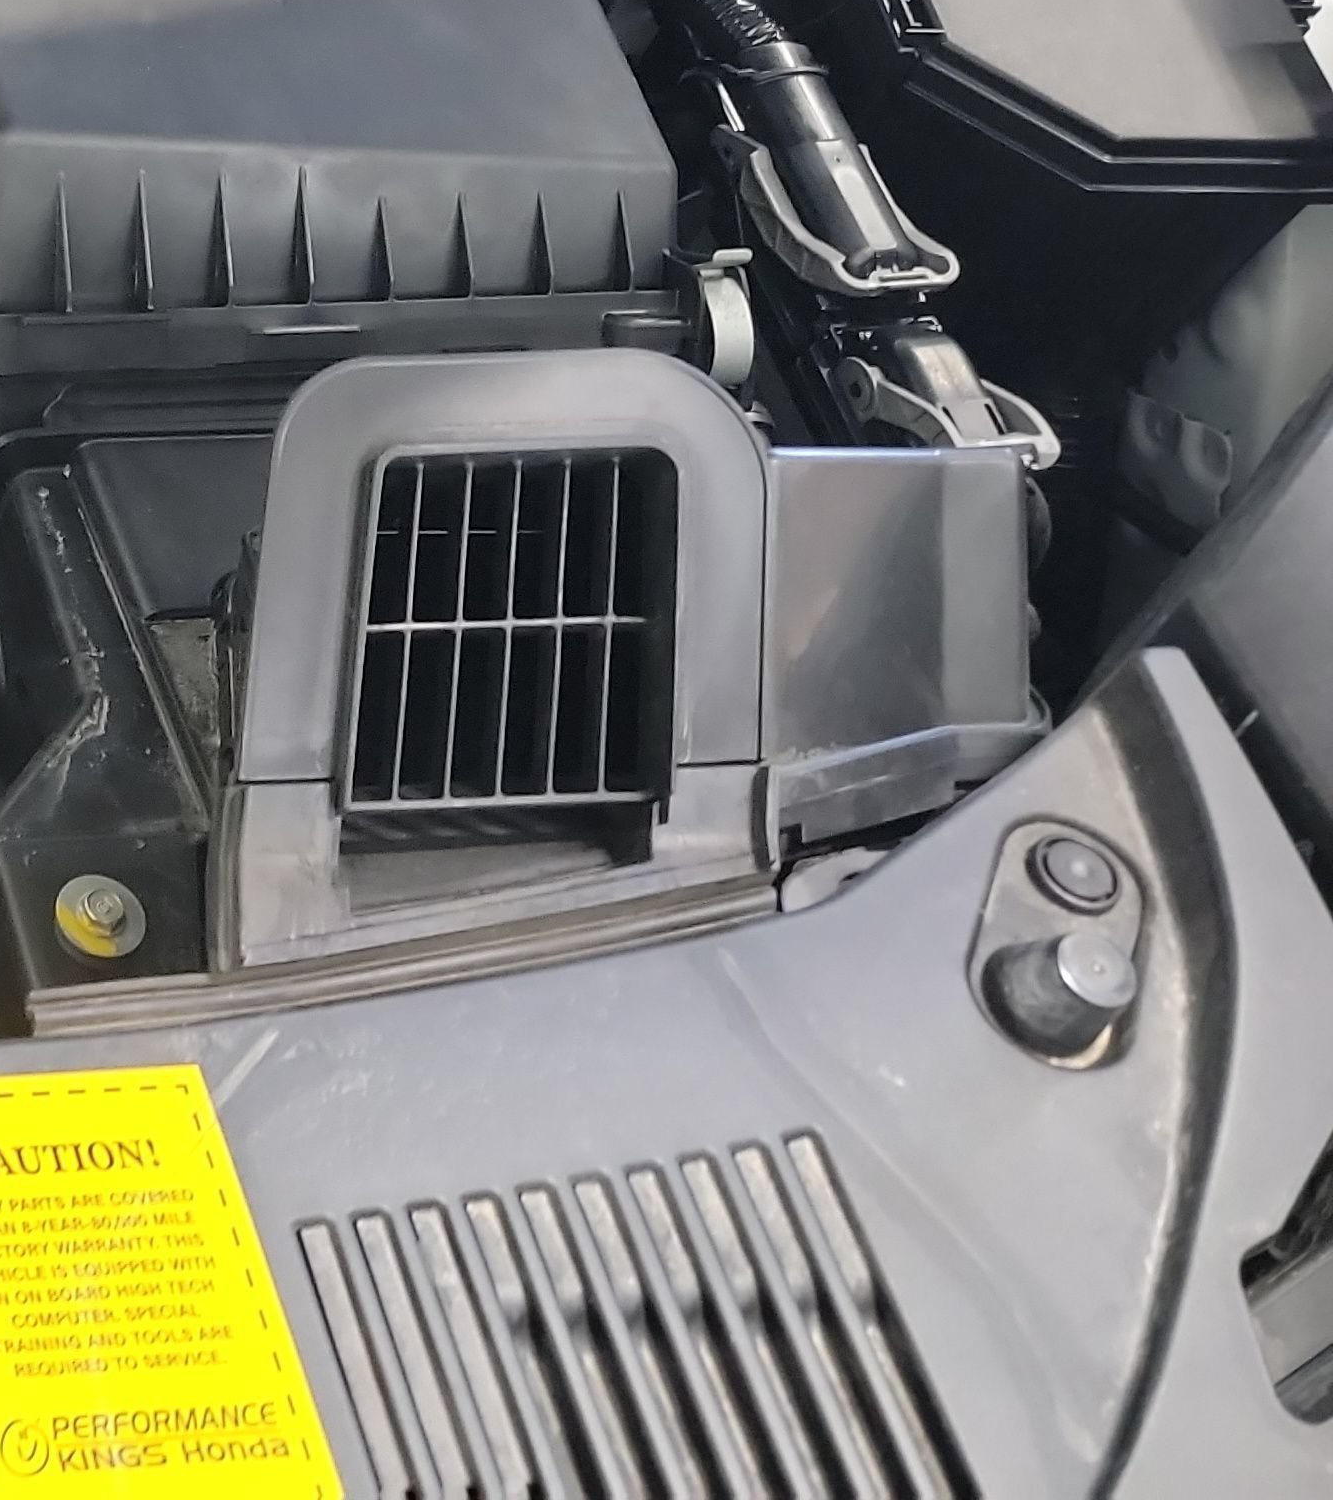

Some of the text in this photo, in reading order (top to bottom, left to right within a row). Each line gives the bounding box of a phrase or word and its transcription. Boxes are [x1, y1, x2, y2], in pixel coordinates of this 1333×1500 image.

[9, 1196, 66, 1212] PARTS
[71, 1193, 104, 1209] ARE
[14, 1356, 110, 1378] REQUIRED
[114, 1354, 139, 1371] TO
[52, 1401, 278, 1440] PERFORMANCE
[57, 1435, 291, 1473] KINGS Honda
